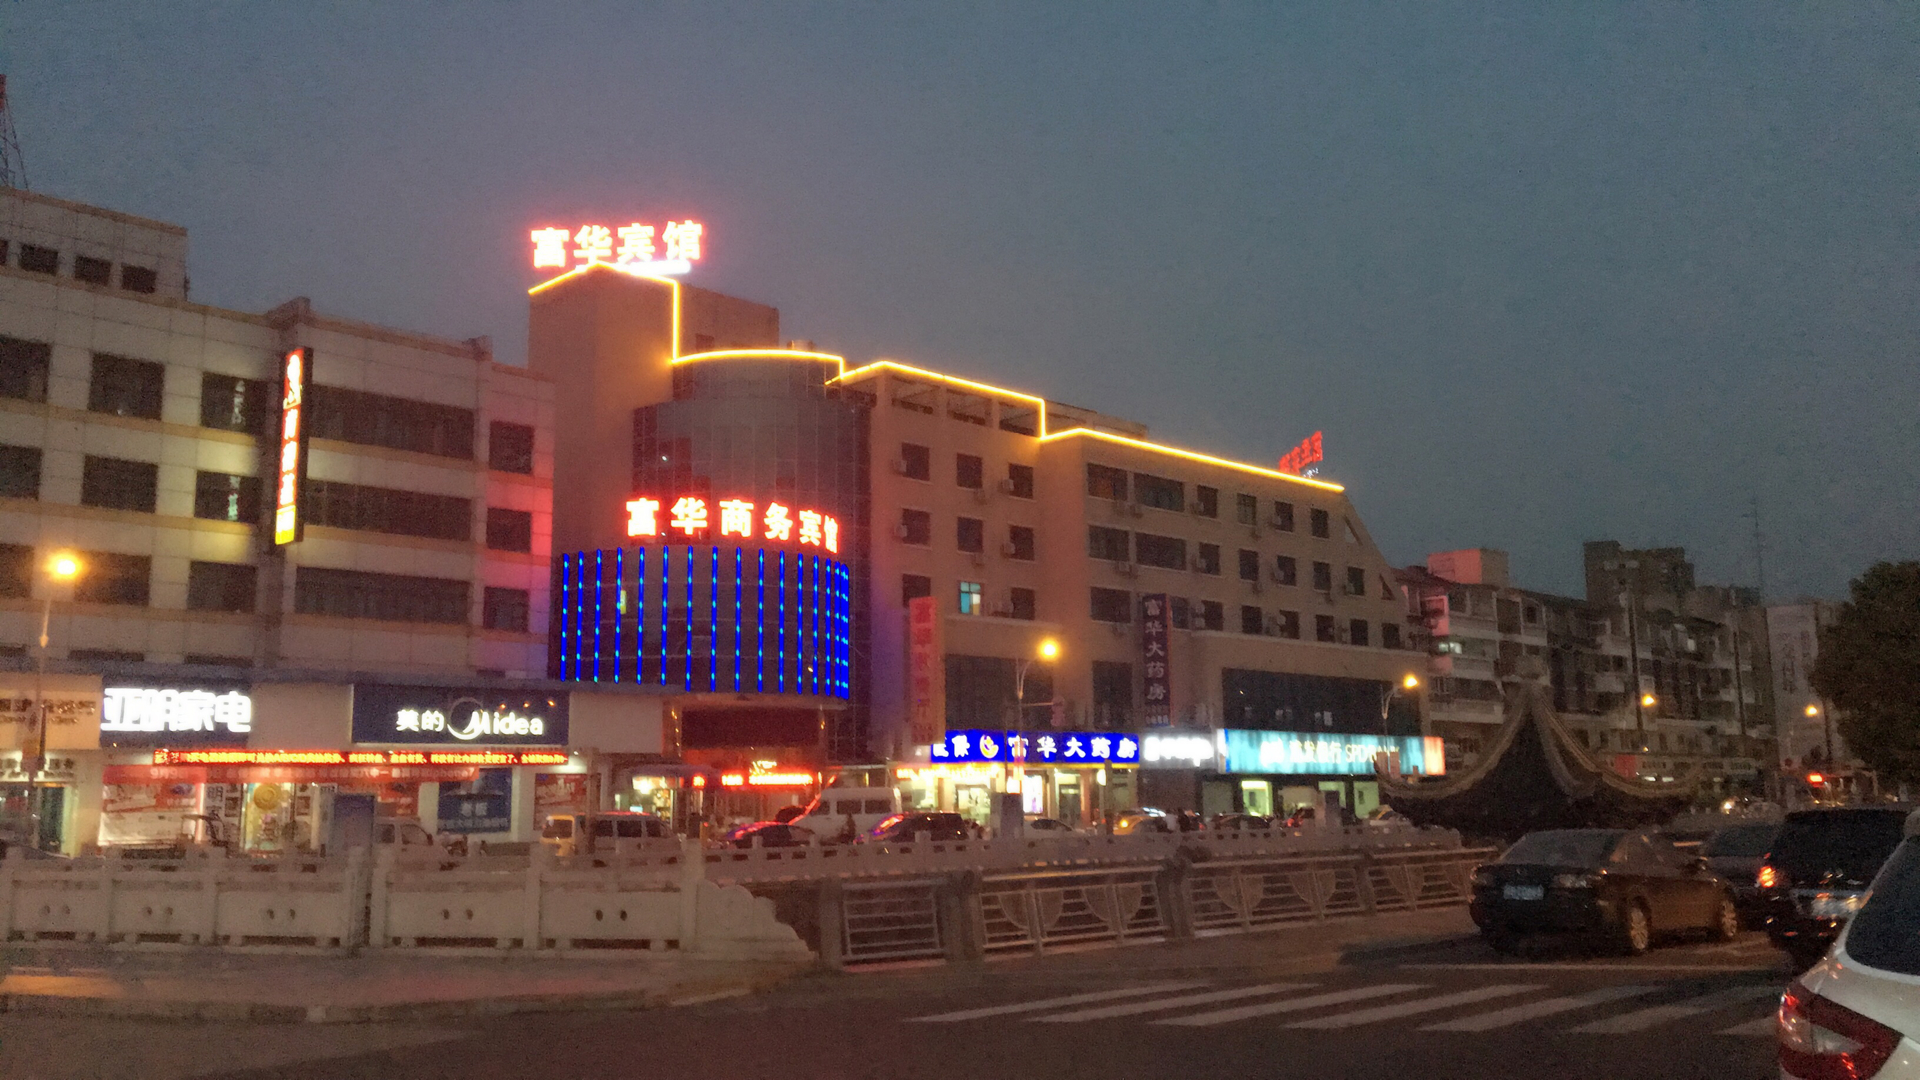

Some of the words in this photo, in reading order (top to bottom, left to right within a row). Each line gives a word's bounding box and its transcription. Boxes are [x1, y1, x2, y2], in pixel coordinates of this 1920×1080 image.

[530, 219, 703, 268] 富华宾馆
[625, 497, 839, 554] 富华商务宾馆
[1144, 599, 1166, 700] 富华大药房
[396, 709, 444, 732] 美的
[454, 711, 543, 738] Midea
